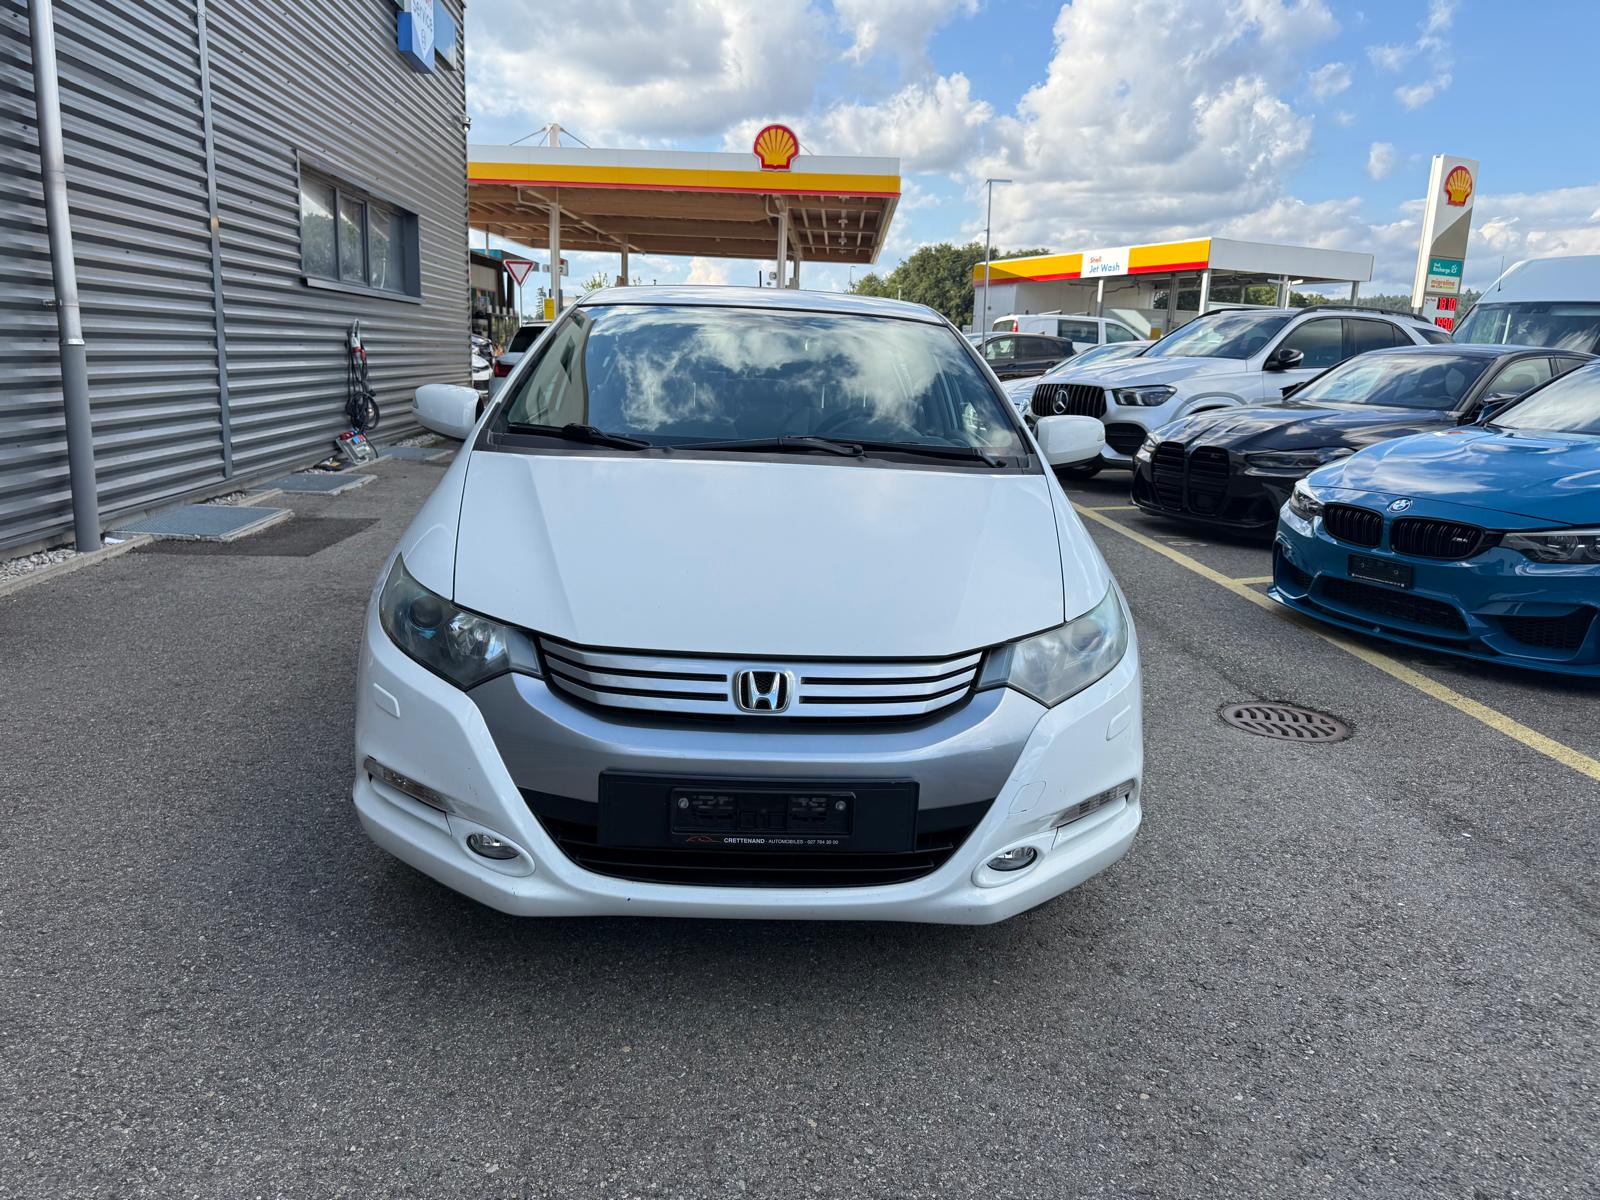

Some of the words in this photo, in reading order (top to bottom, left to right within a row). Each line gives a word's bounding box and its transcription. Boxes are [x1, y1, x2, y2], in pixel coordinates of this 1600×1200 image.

[1090, 255, 1102, 263] Shell
[1089, 265, 1099, 274] Jet
[1101, 261, 1120, 272] Wash
